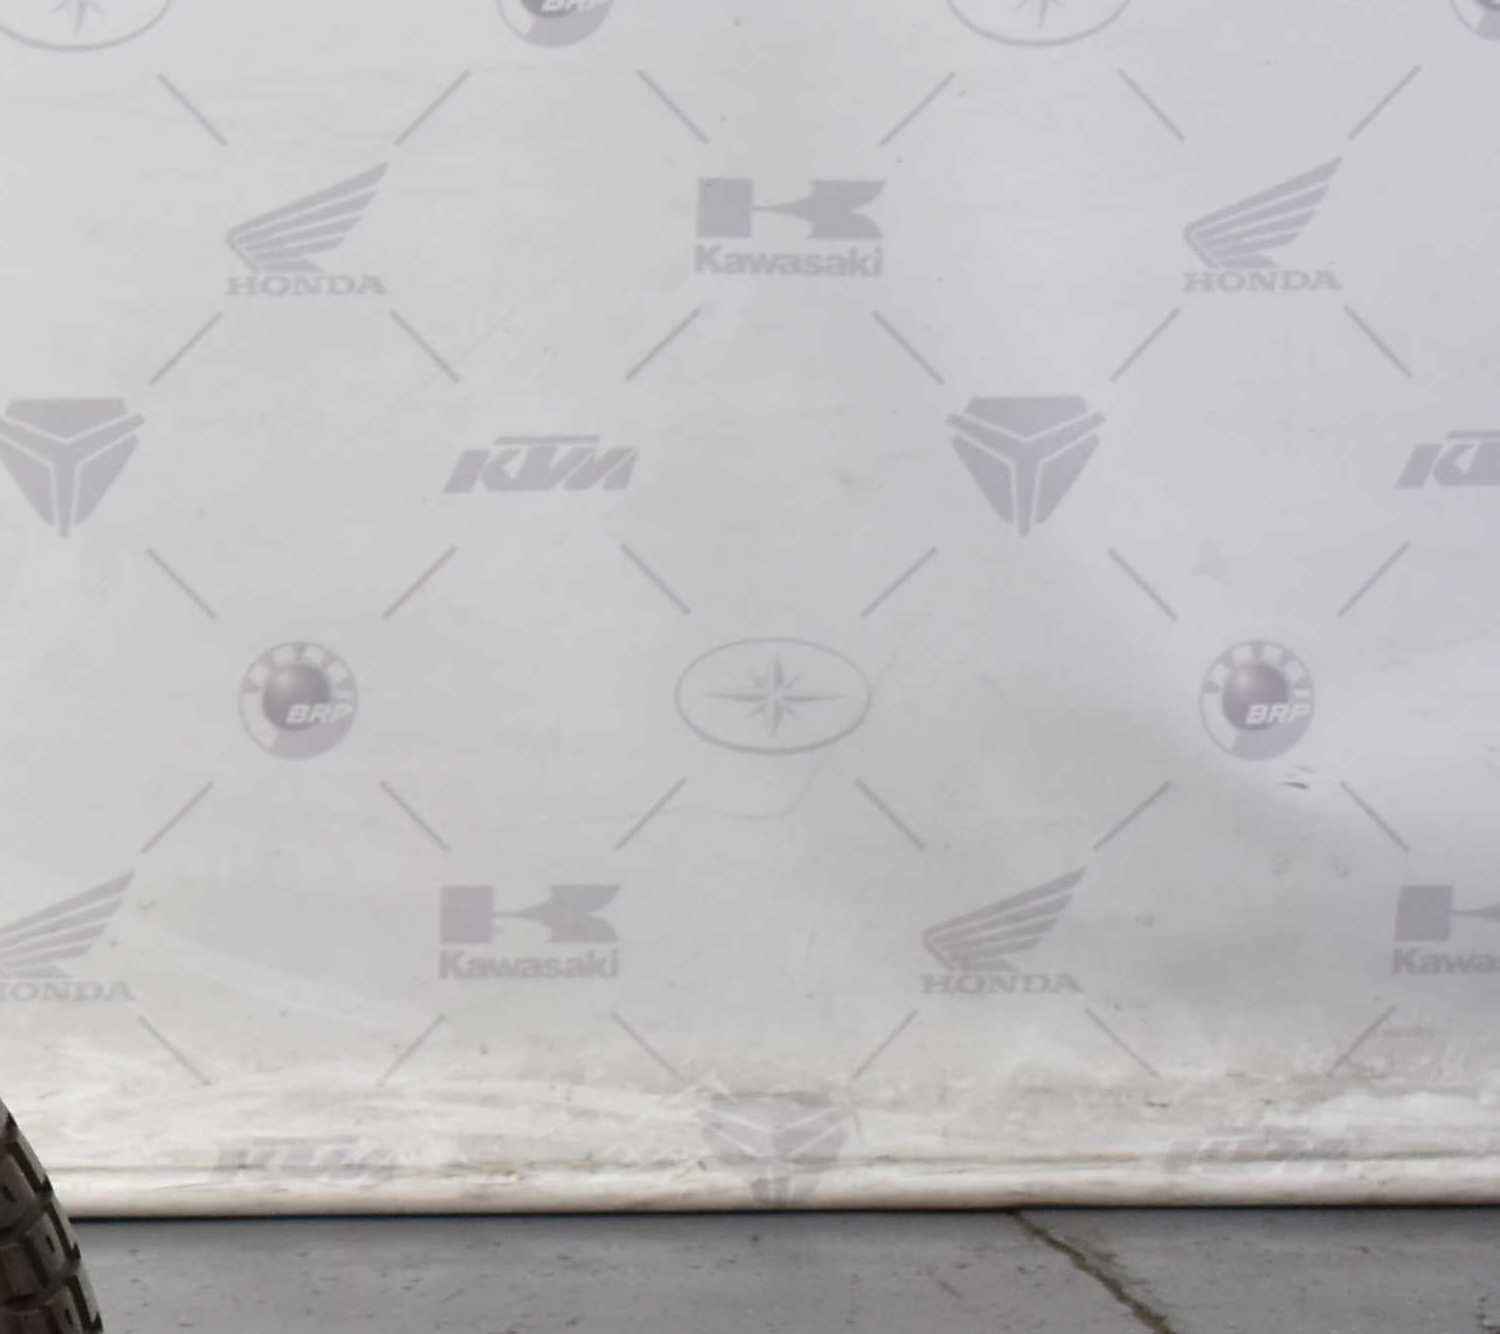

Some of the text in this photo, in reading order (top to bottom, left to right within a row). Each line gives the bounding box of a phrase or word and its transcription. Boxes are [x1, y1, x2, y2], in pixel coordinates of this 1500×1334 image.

[695, 244, 882, 277] Kawasaki
[227, 275, 388, 296] HONDA
[1184, 271, 1342, 292] HONDA
[444, 435, 638, 493] KTM
[285, 703, 353, 725] BRP
[1245, 703, 1310, 725] BRP
[439, 949, 620, 980] Kawasaki
[922, 973, 1084, 995] HONDA
